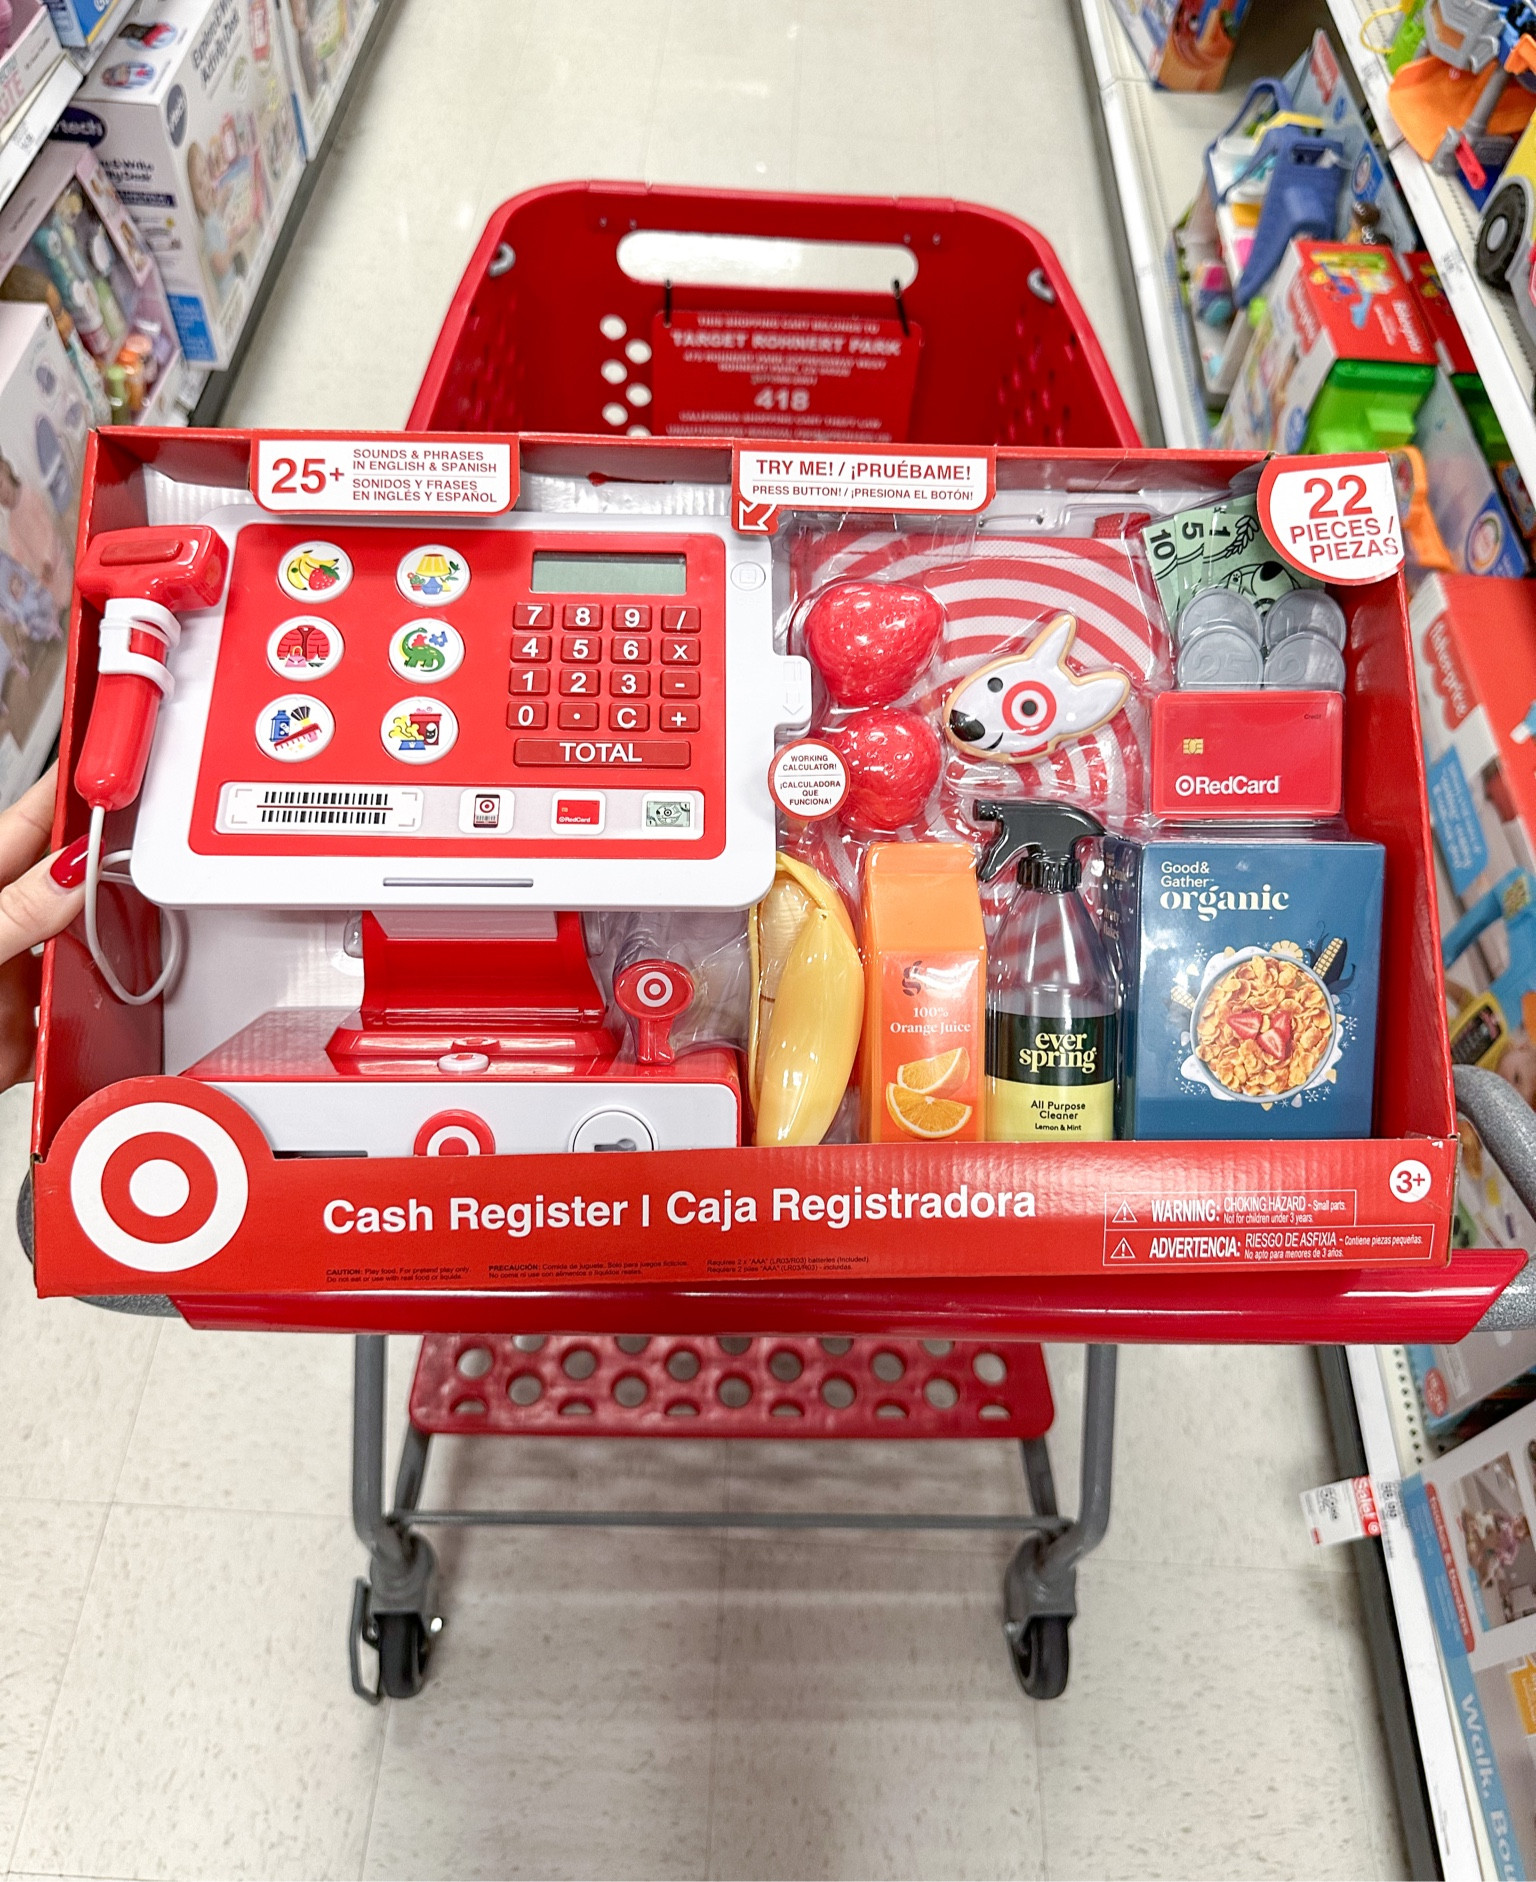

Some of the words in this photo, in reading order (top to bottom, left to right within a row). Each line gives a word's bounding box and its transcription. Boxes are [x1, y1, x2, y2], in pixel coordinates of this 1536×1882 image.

[672, 330, 748, 349] TARGET
[751, 333, 846, 353] ROHNERT
[849, 338, 901, 356] PARK
[754, 386, 810, 411] 418
[353, 449, 407, 460] SOUNDS
[411, 450, 420, 460] &
[423, 450, 484, 461] PHRASES
[352, 460, 365, 471] IN
[369, 461, 425, 472] ENGLISH
[429, 462, 437, 472] &
[441, 462, 497, 473] SPANISH
[756, 459, 793, 475] TRY
[800, 460, 833, 476] ME!
[838, 461, 845, 476] /
[850, 460, 971, 481] ¡PRUÉBAME!
[271, 457, 345, 495] 25+
[352, 478, 411, 489] SONIDOS
[415, 479, 423, 489] Y
[426, 479, 478, 490] FRASES
[352, 490, 370, 501] EN
[373, 489, 421, 502] INGLÉS
[424, 491, 433, 502] Y
[436, 489, 498, 503] ESPAÑOL
[752, 485, 790, 496] PRESS
[793, 486, 842, 497] BUTTON!
[851, 487, 911, 500] ¡PRESIONA
[914, 489, 928, 500] EL
[931, 487, 973, 501] BOTÓN!
[1303, 474, 1373, 521] 22
[1182, 521, 1204, 540] 5
[1289, 516, 1381, 544] PIECES
[1387, 515, 1394, 535] /
[1149, 528, 1175, 561] 10
[1310, 536, 1399, 563] PIEZAS
[527, 605, 543, 625] 7
[574, 606, 591, 626] 8
[624, 608, 641, 628] 9
[675, 610, 687, 631] /
[521, 637, 539, 658] 4
[572, 639, 589, 659] 5
[622, 640, 639, 660] 6
[521, 670, 535, 691] 1
[570, 672, 587, 693] 2
[620, 674, 637, 694] 3
[517, 705, 535, 727] 0
[616, 707, 637, 729] C
[558, 741, 643, 763] TOTAL
[790, 754, 829, 762] WORKING
[782, 763, 837, 771] CALCULATOR!
[780, 780, 841, 789] ¡CALCULADORA
[801, 789, 819, 797] QUE
[1195, 774, 1281, 796] RedCard
[789, 798, 832, 806] FUNCIONA!
[564, 816, 591, 824] RedCard
[1160, 874, 1209, 888] Gather
[1159, 883, 1290, 922] organic
[912, 1006, 949, 1018] 100%
[890, 1021, 938, 1036] Orange
[939, 1021, 971, 1034] Juice
[1034, 1032, 1088, 1050] ever
[1019, 1046, 1098, 1074] spring
[1030, 1099, 1045, 1109] All
[1047, 1101, 1086, 1112] Purpose
[1039, 1110, 1079, 1120] Cleaner
[1034, 1123, 1059, 1131] Lemon
[1066, 1123, 1082, 1131] Mint
[1395, 1169, 1426, 1194] 3+
[322, 1198, 434, 1235] Cash
[450, 1194, 629, 1238] Register
[665, 1189, 758, 1232] Caja
[771, 1184, 1037, 1230] Registradora
[1151, 1199, 1220, 1222] WARNING:
[1223, 1196, 1267, 1213] CHOKING
[1268, 1195, 1306, 1212] HAZARD
[1312, 1199, 1329, 1212] Small
[1330, 1200, 1346, 1213] parts.
[1223, 1213, 1235, 1224] Not
[1235, 1212, 1245, 1224] for
[1245, 1212, 1270, 1224] children
[1270, 1212, 1289, 1224] under
[1289, 1212, 1295, 1223] 3
[1295, 1212, 1314, 1225] years.
[1149, 1236, 1241, 1259] ADVERTENCIA:
[1245, 1232, 1283, 1248] RIESGO
[1284, 1232, 1299, 1247] DE
[1299, 1231, 1337, 1247] ASFIXIA
[1344, 1235, 1371, 1246] Contiene
[1371, 1235, 1391, 1247] piezas
[1391, 1234, 1423, 1247] pequeñas.
[1244, 1249, 1254, 1260] No
[1254, 1249, 1269, 1261] apto
[1269, 1250, 1284, 1261] para
[1284, 1248, 1311, 1259] menores
[1312, 1247, 1321, 1258] de
[1321, 1247, 1327, 1258] 3
[1327, 1247, 1344, 1258] años.
[326, 1268, 362, 1276] CAUTION:
[364, 1268, 380, 1276] Play
[399, 1267, 412, 1275] For
[412, 1266, 438, 1275] pretend
[439, 1266, 454, 1274] play
[415, 1273, 430, 1281] food
[1353, 1476, 1377, 1519] Sale!
